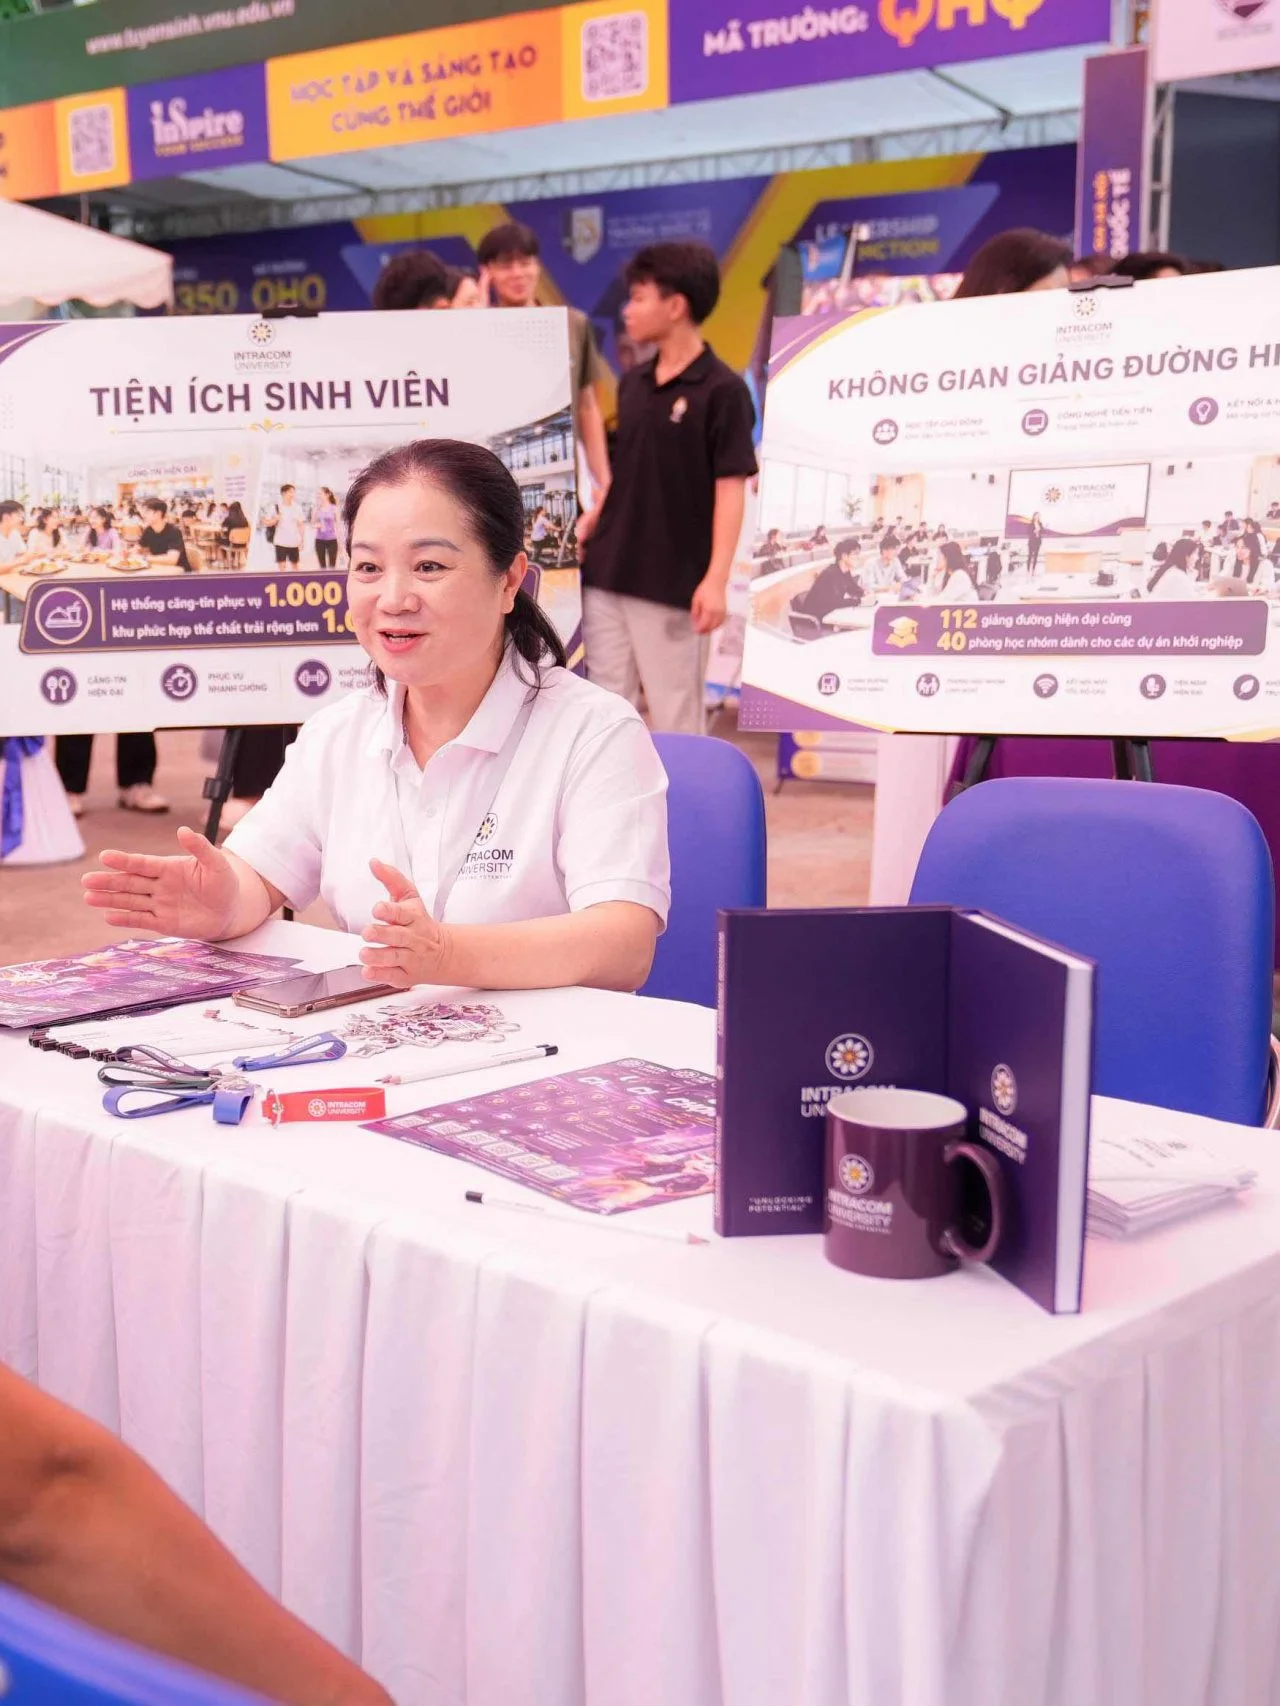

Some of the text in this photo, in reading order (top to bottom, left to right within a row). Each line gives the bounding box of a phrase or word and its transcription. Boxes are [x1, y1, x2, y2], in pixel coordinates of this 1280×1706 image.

[703, 20, 744, 56] MÃ
[290, 79, 333, 103] HỌC
[387, 60, 413, 85] VÀ
[422, 52, 481, 83] SÁNG
[489, 46, 536, 77] TẠO
[331, 102, 390, 132] CÙNG
[443, 84, 491, 116] GIỚI
[234, 351, 292, 360] INTRACOM
[827, 370, 929, 401] KHÔNG
[938, 366, 1008, 391] GIAN
[1019, 353, 1114, 386] GIẢNG
[1123, 346, 1238, 379] ĐƯỜNG
[90, 371, 450, 422] TIỆN ÍCH SINH VIÊN
[111, 599, 127, 613] Hệ
[131, 597, 164, 612] thống
[247, 596, 262, 609] vụ
[264, 582, 342, 607] 1.000
[112, 625, 134, 638] khu
[296, 619, 319, 632] hơn
[940, 609, 977, 629] 112
[981, 612, 1012, 628] giảng
[937, 631, 966, 651] 40
[968, 635, 1002, 650] phòng
[1090, 635, 1112, 648] cho
[327, 1101, 367, 1109] INTRACOM
